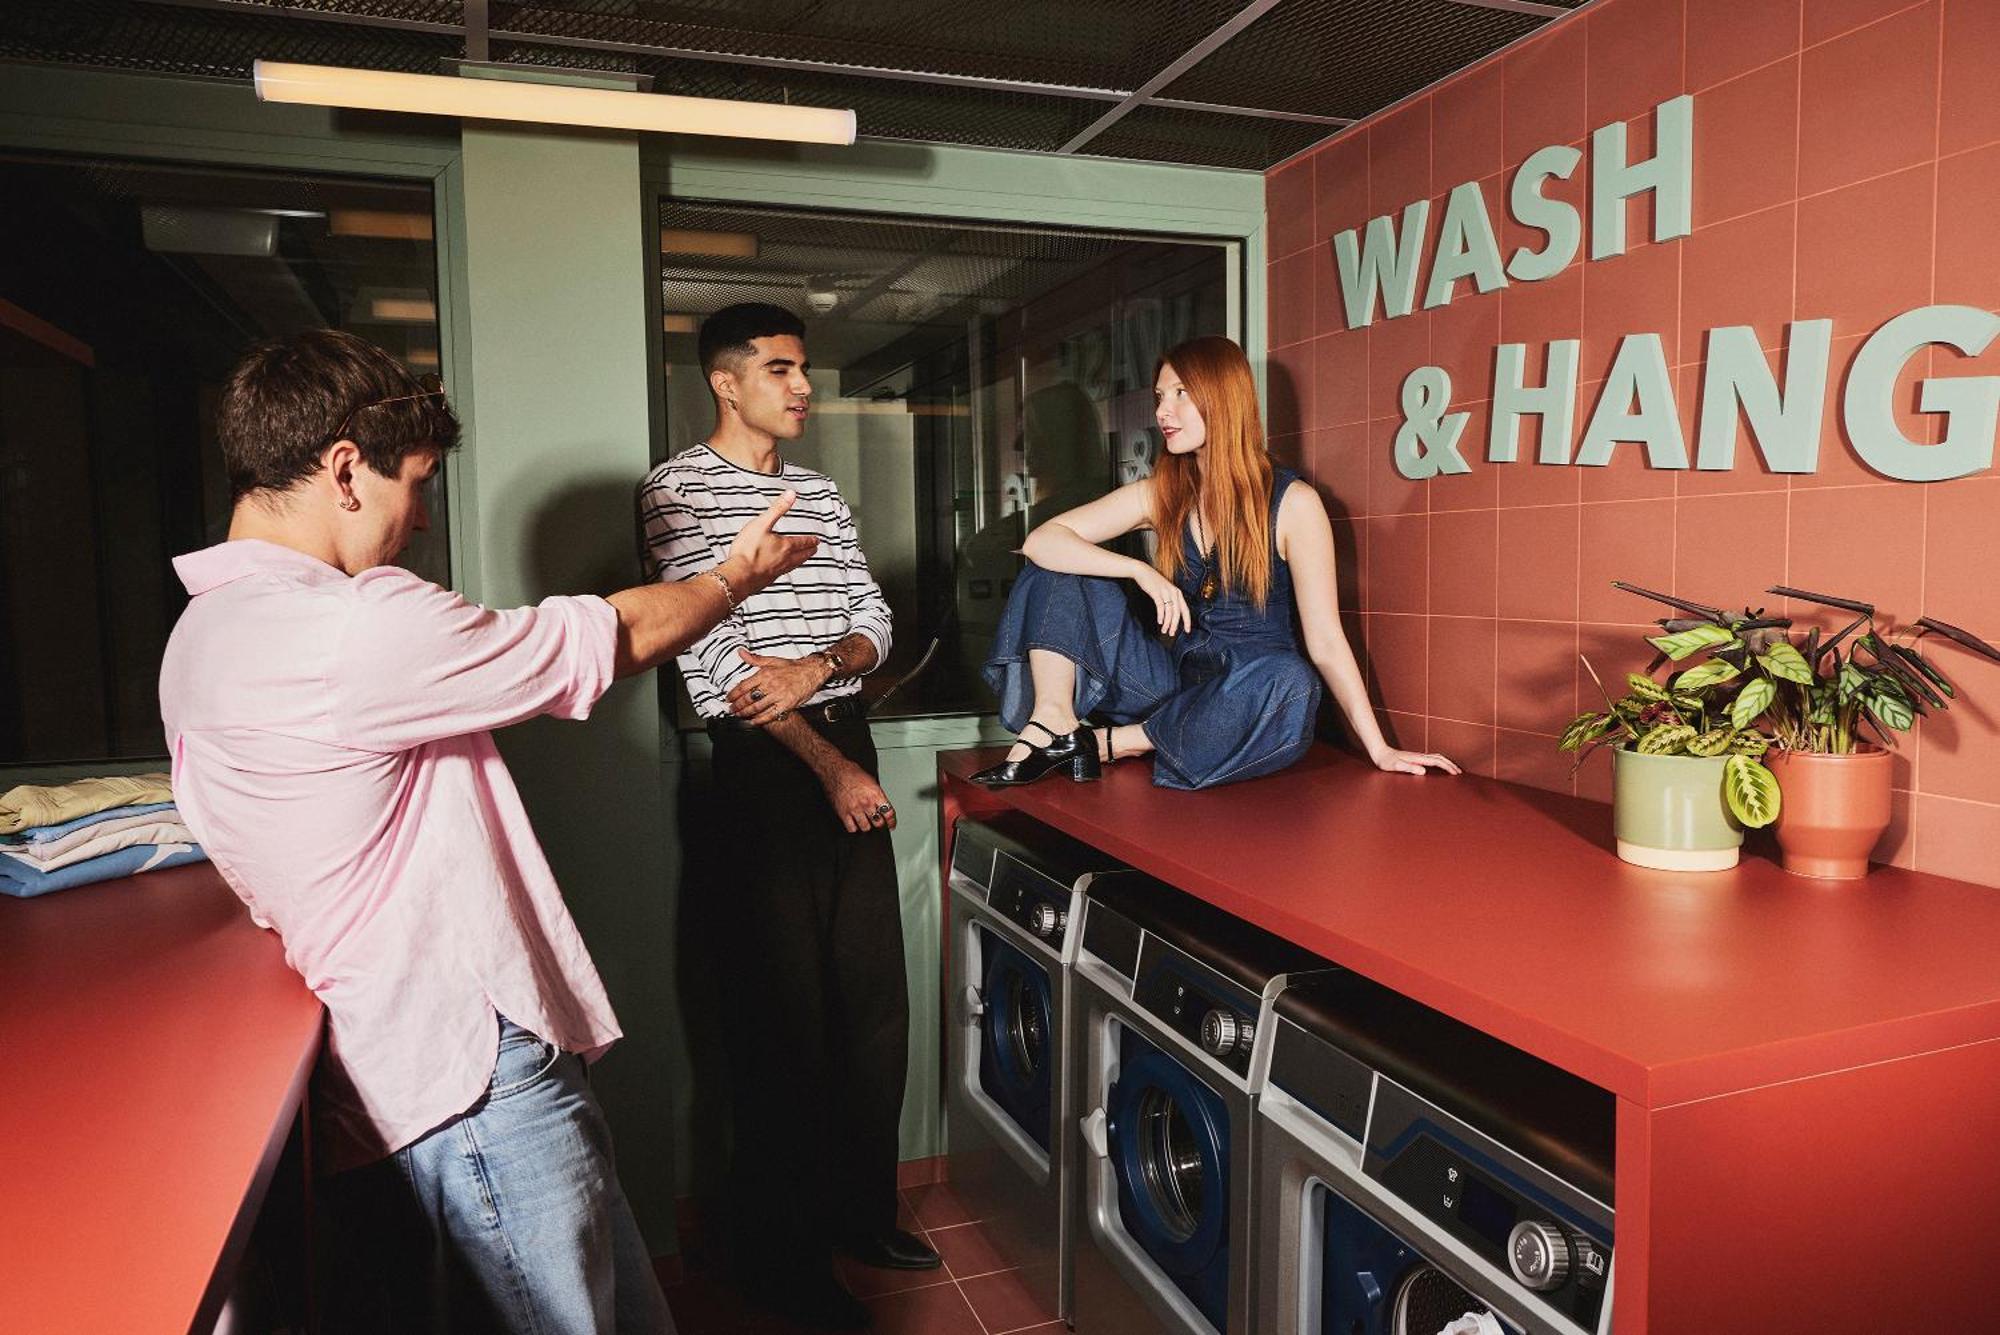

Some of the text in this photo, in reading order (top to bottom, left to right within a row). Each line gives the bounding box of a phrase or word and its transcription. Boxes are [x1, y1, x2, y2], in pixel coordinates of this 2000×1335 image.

[1333, 94, 1694, 330] WASH
[1394, 304, 2000, 483] & HANG
